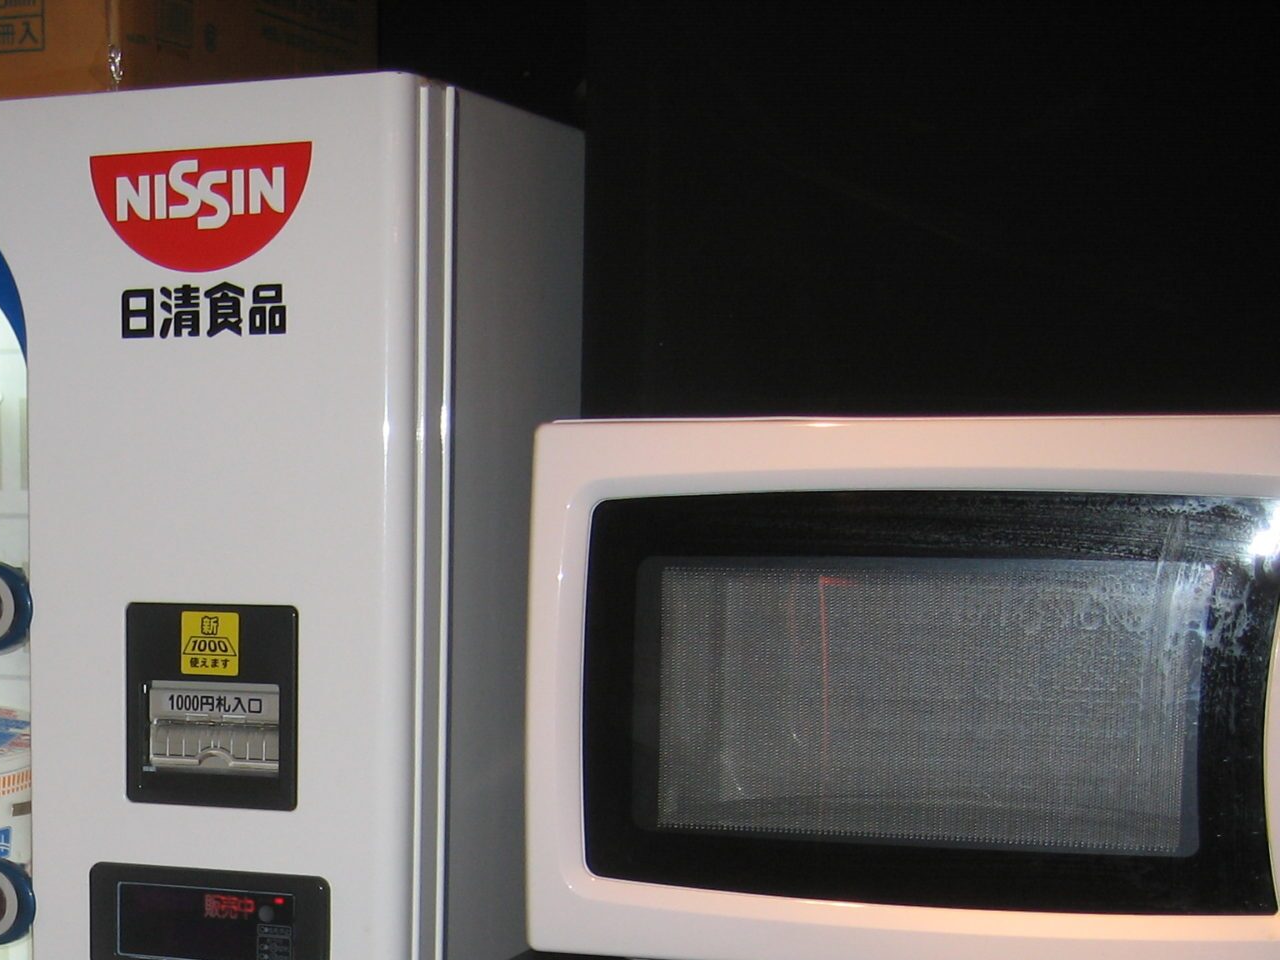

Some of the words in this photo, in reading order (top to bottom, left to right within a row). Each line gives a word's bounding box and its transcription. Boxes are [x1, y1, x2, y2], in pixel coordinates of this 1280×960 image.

[116, 160, 284, 230] NISSIN
[122, 281, 286, 339] 日清食品
[201, 616, 219, 635] 新
[190, 639, 228, 653] 1000
[190, 657, 230, 669] 使えます
[169, 695, 263, 714] 1000円札入口
